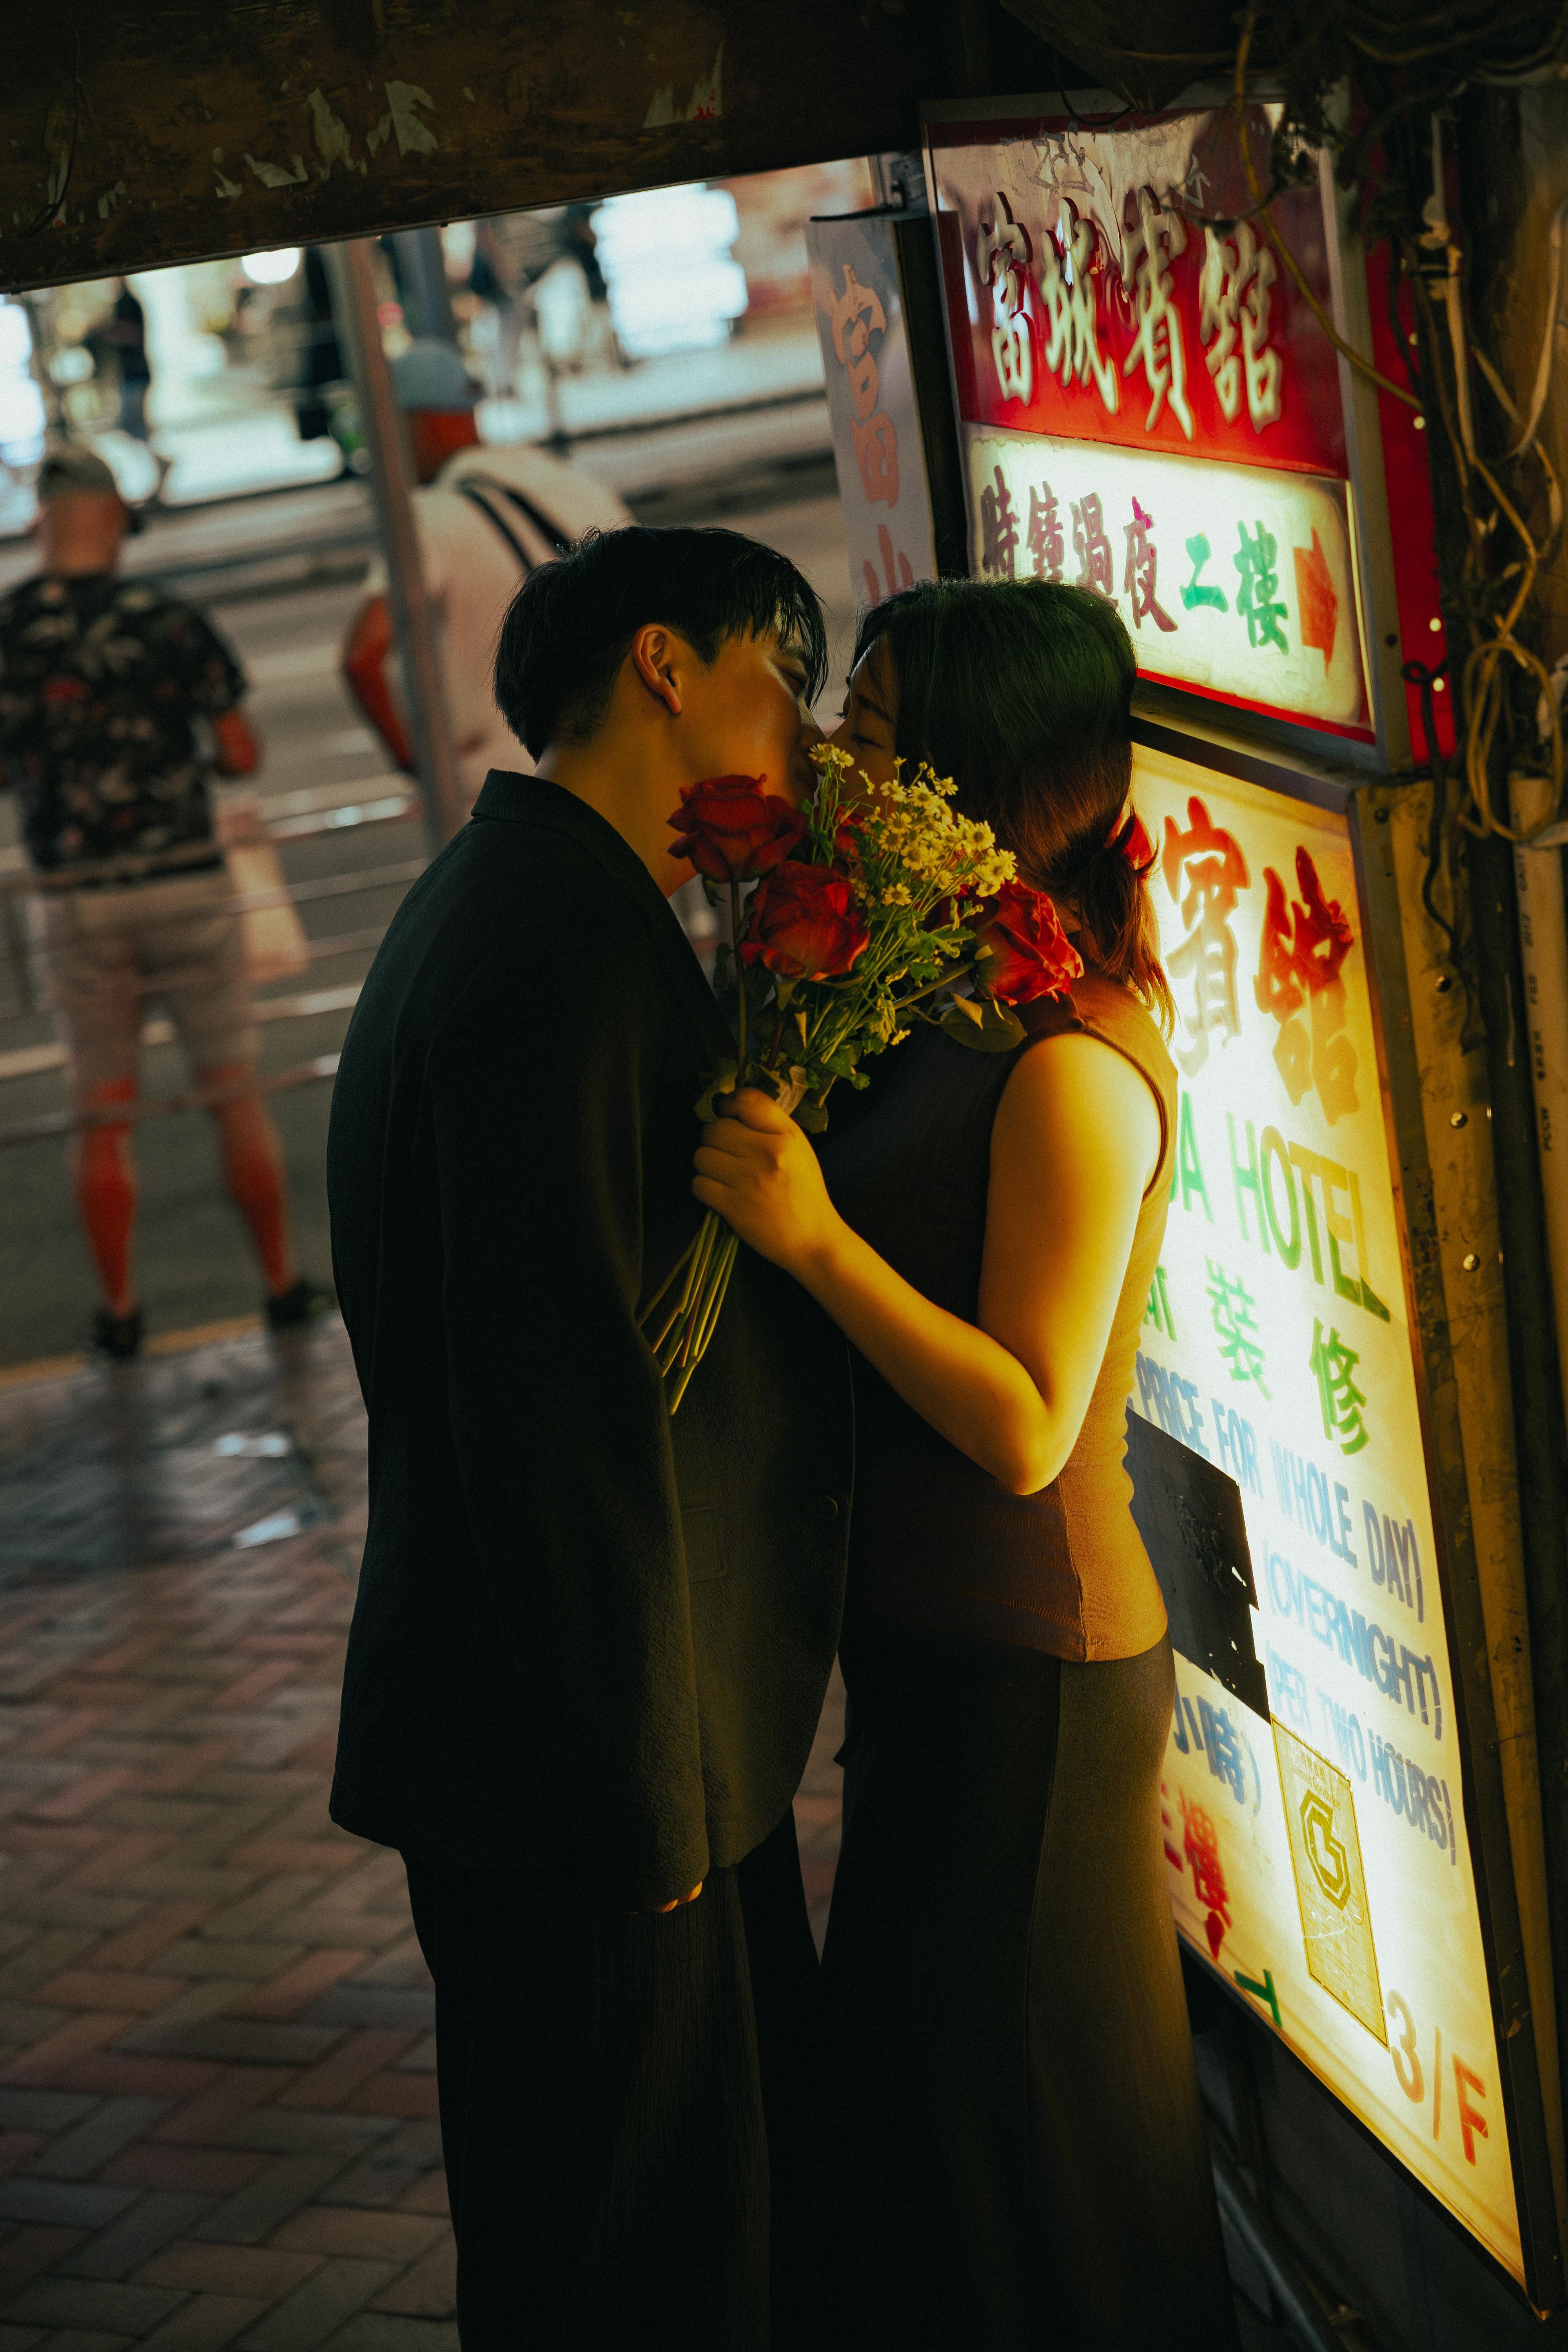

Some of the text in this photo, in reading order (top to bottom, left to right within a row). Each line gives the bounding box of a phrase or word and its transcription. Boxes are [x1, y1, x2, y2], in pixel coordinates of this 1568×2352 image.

[1227, 1110, 1391, 1323] HOTEL
[1135, 1350, 1211, 1461] PRICE
[1210, 1397, 1265, 1501] FOR
[1269, 1437, 1358, 1569] WHOLE
[1316, 1686, 1367, 1782] TWO
[1387, 1989, 1489, 2167] 3/F
